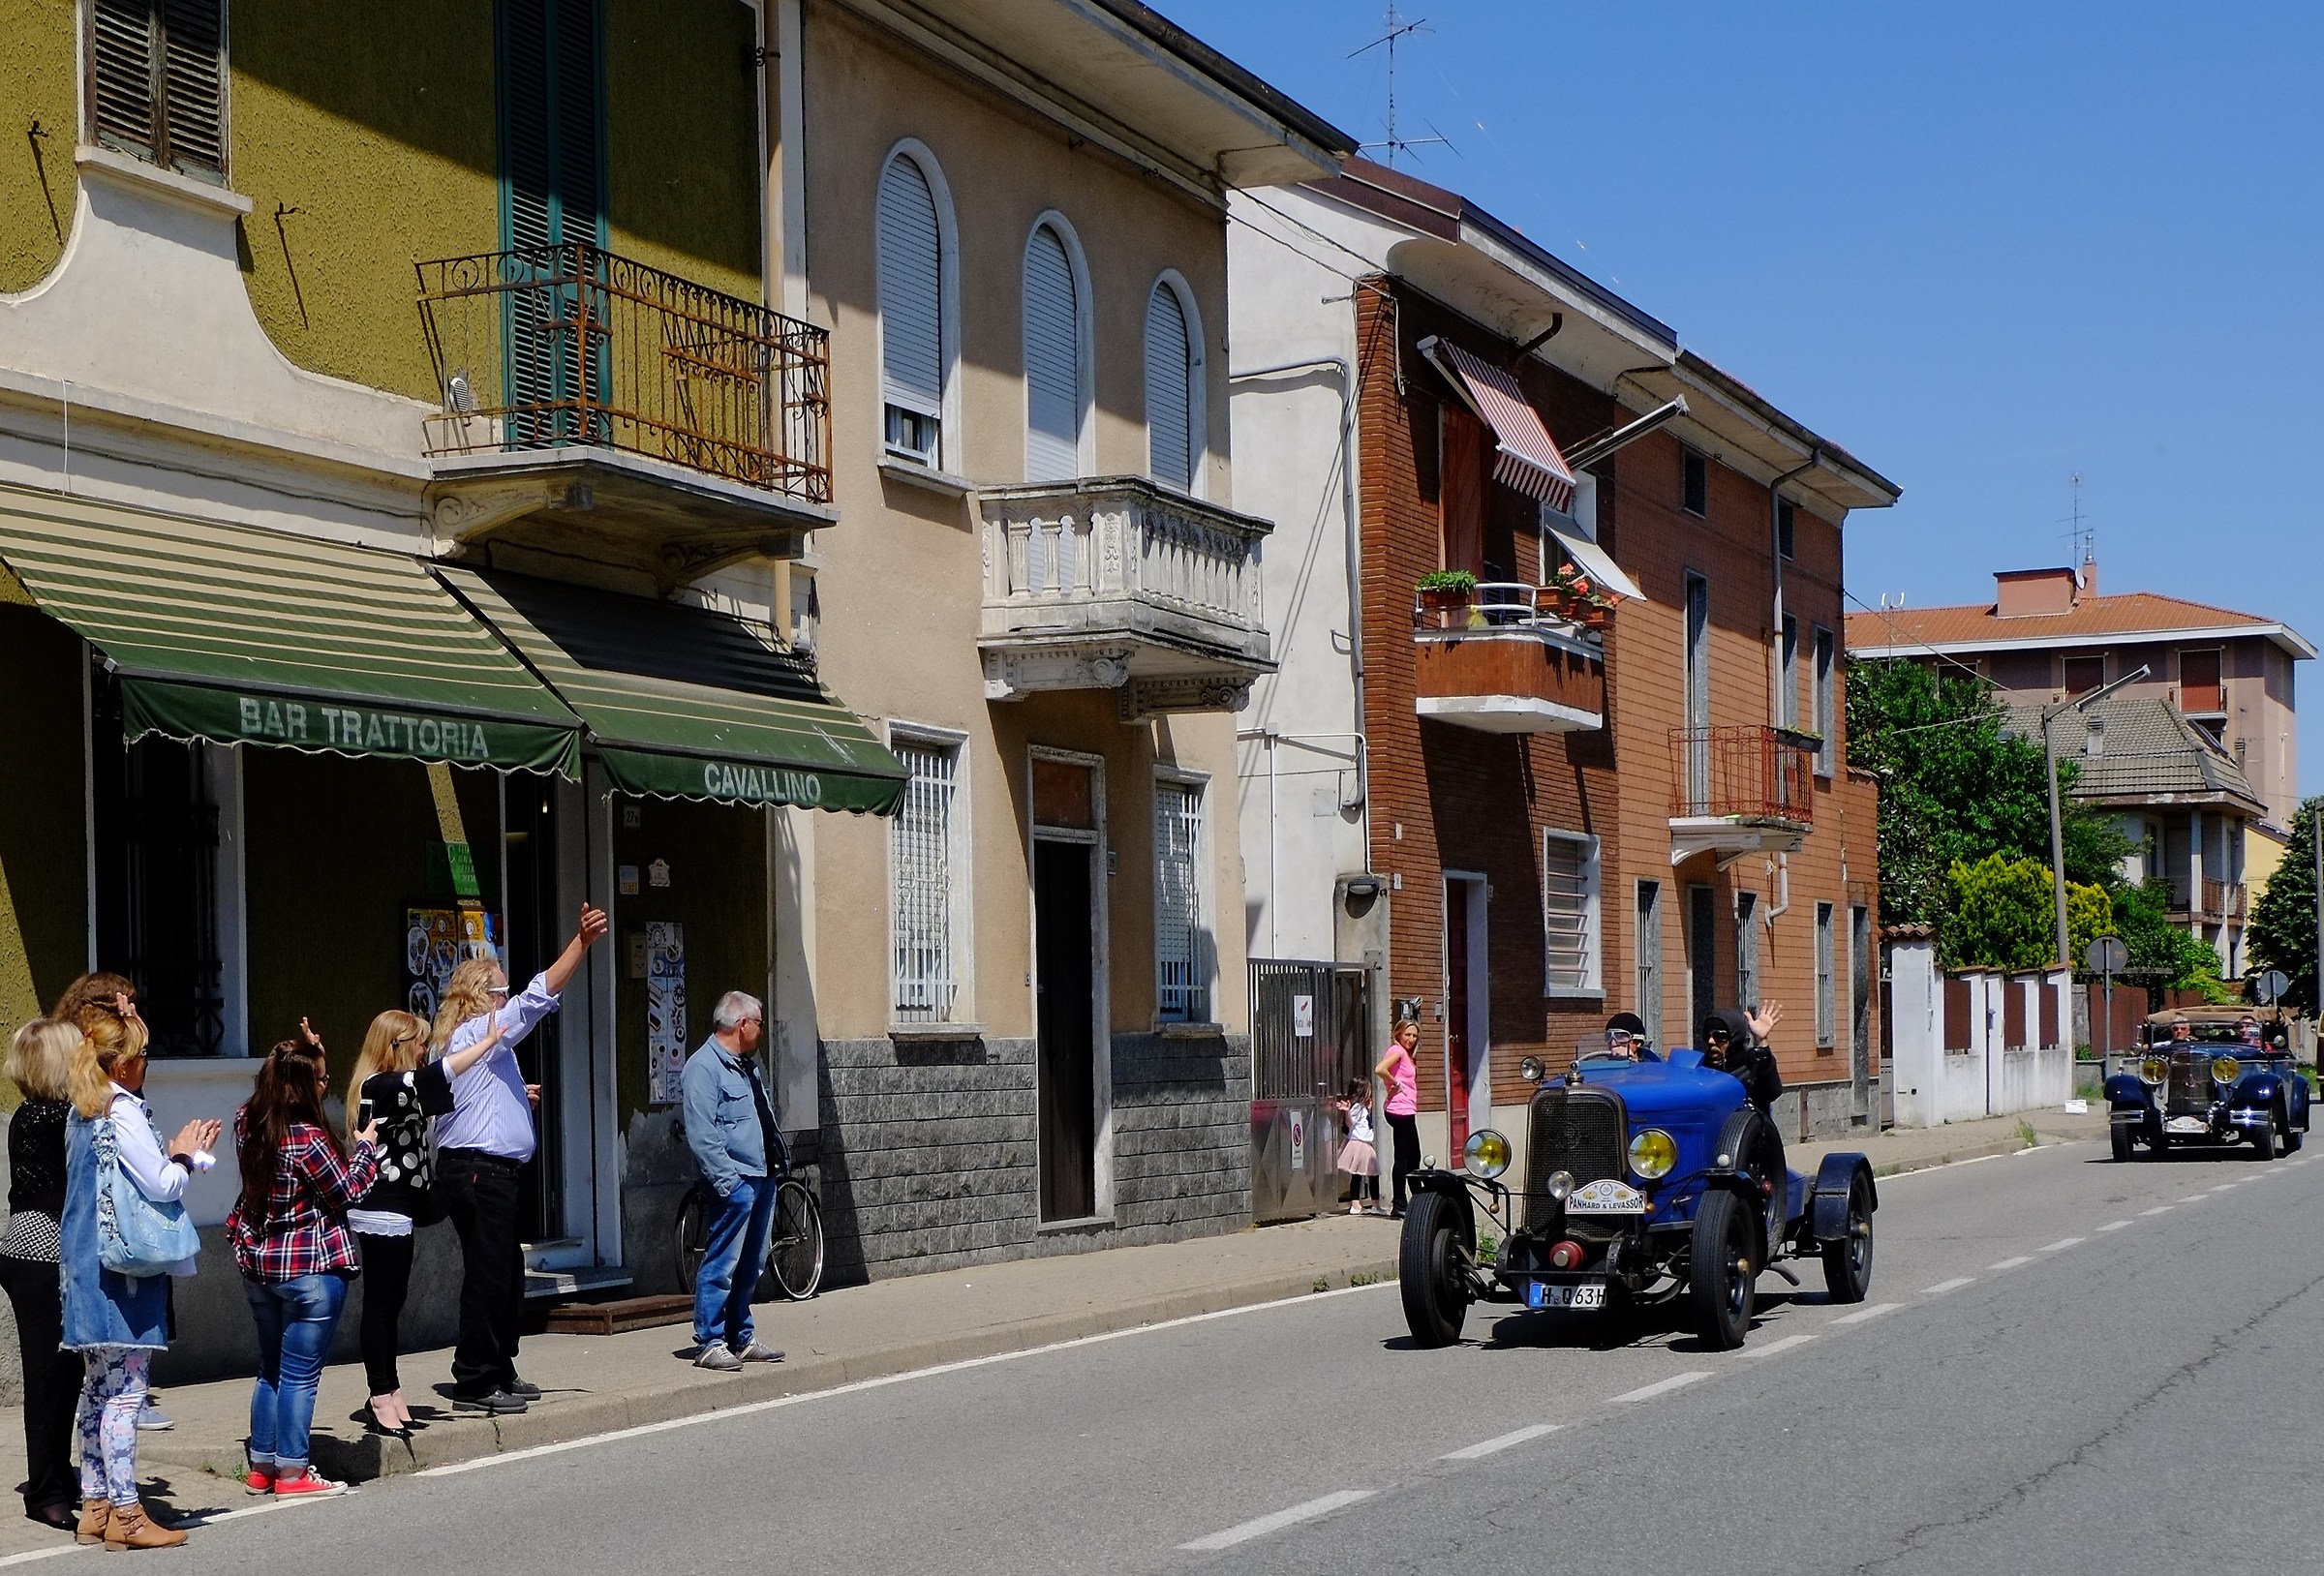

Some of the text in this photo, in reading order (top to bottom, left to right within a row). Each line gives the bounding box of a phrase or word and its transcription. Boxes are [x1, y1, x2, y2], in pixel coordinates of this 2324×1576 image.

[239, 697, 490, 758] BAR TRATTORIA
[704, 763, 822, 803] CAVALLINO
[1569, 1196, 1601, 1209] PANHARD
[1608, 1195, 1644, 1209] LEVASSOR
[1542, 1288, 1552, 1305] H
